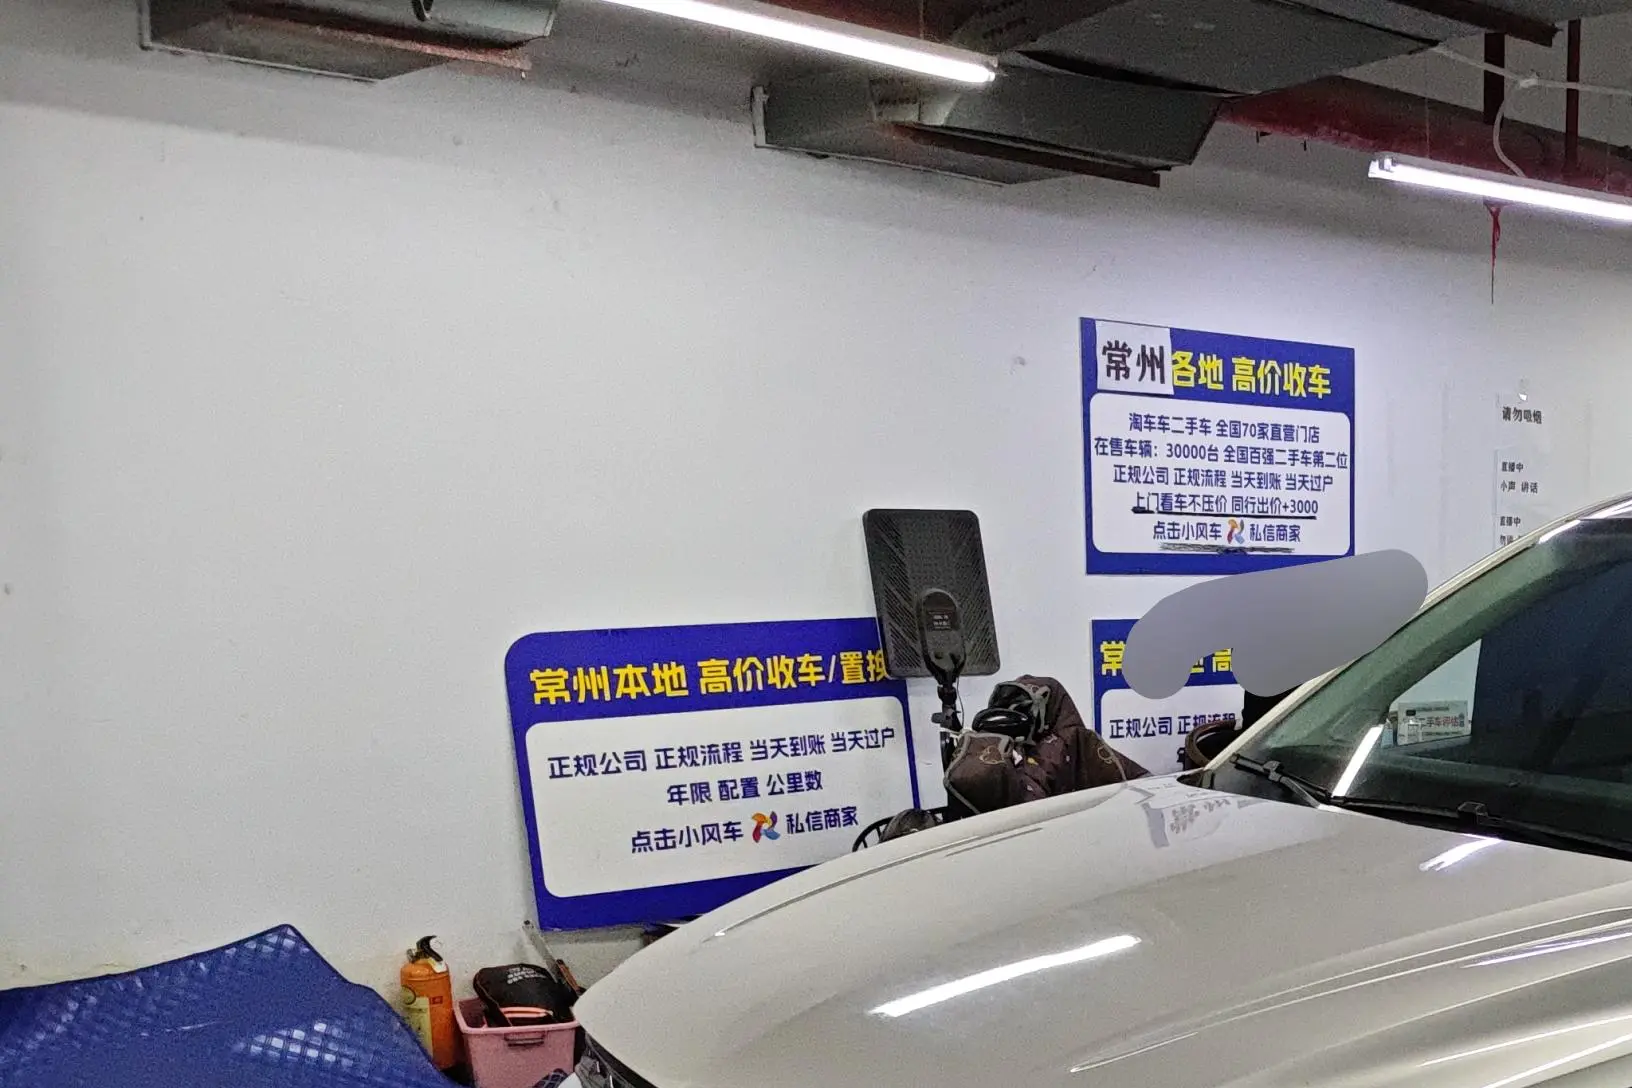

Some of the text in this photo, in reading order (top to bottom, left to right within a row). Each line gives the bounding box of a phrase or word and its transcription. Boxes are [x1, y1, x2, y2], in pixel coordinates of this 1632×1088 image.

[1232, 356, 1332, 399] 高价收车
[1129, 412, 1320, 443] 淘车车二手车 全国70家直营门店
[1502, 406, 1542, 424] 请勿吸烟
[1223, 445, 1348, 469] 全国百强二手车第二位
[1113, 464, 1334, 492] 正规公司 正规流程 当天到账 当天过户
[1134, 491, 1319, 515] 上门看车不压价 同行出价+3000
[1152, 521, 1301, 542] 点击小风车 私信商家
[529, 661, 689, 705] 常州本地
[1109, 716, 1172, 739] 正规公司
[548, 727, 895, 779] 正规公司 正规流程 当天到账 当天过户
[667, 770, 824, 806] 年限 配置 公里数
[631, 806, 859, 853] 点击小风车 私信商家
